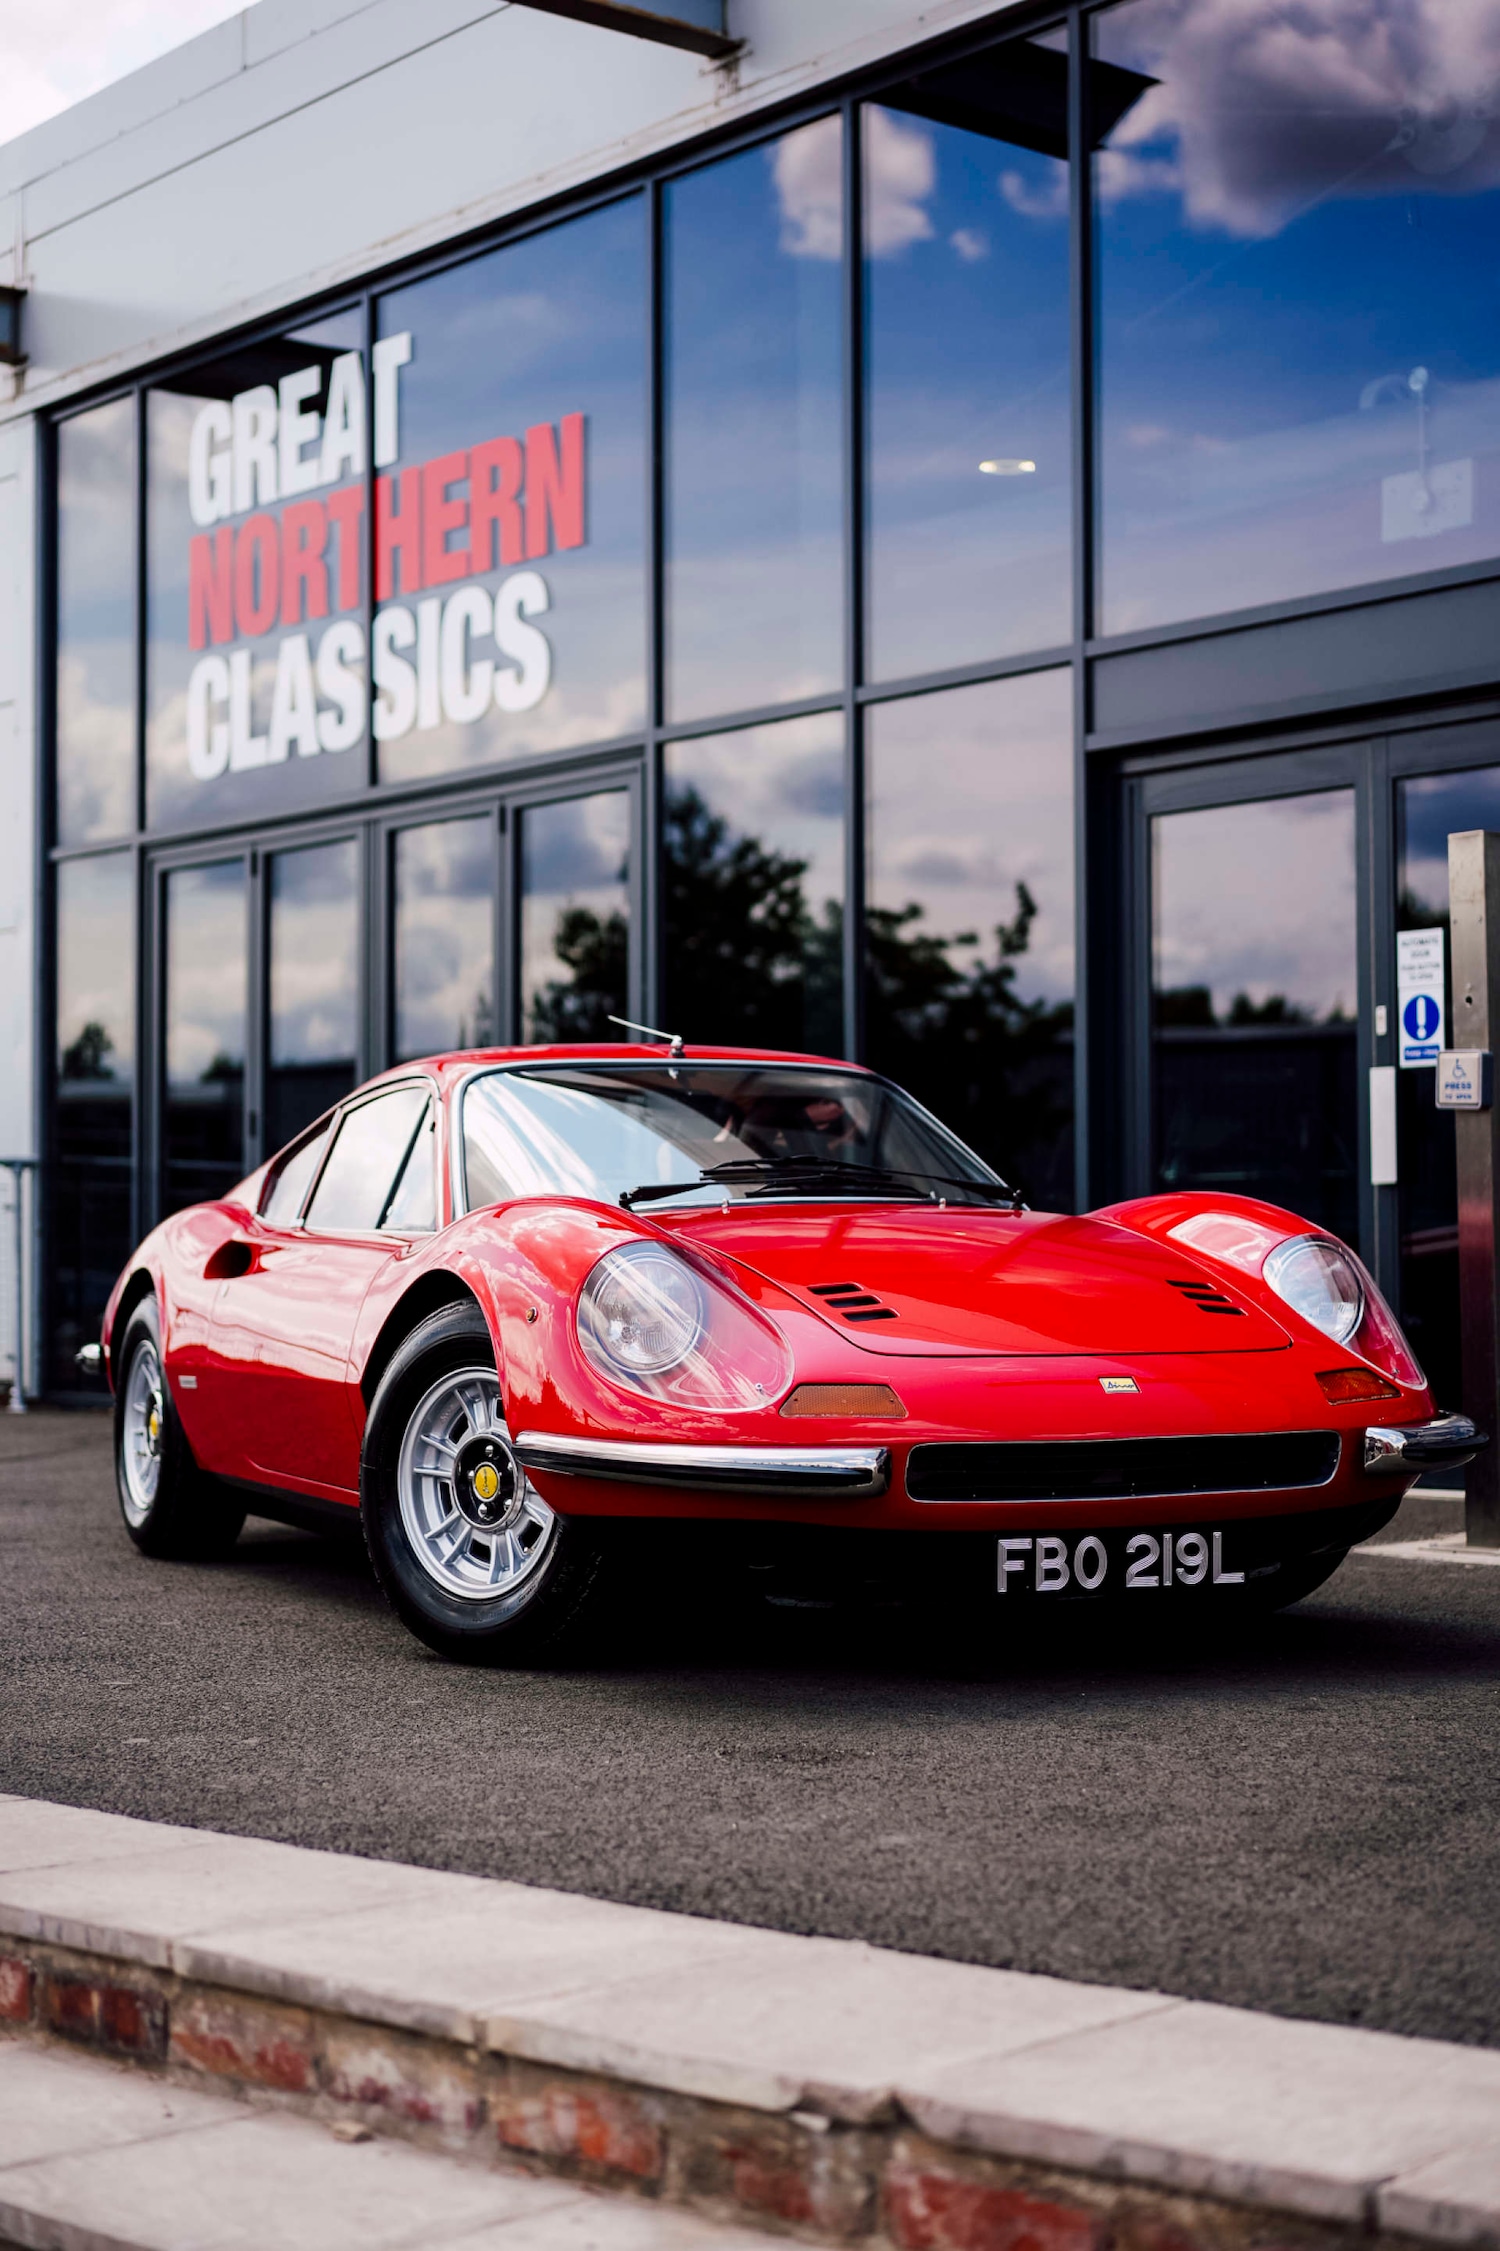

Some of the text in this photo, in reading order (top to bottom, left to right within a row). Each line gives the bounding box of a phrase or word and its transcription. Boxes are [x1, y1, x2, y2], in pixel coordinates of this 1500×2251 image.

[188, 332, 412, 527] GREAT
[188, 411, 585, 650] NORTHERN
[187, 571, 551, 781] CLASSICS
[1445, 1081, 1472, 1090] PRESS
[997, 1531, 1245, 1592] FBO 219L
